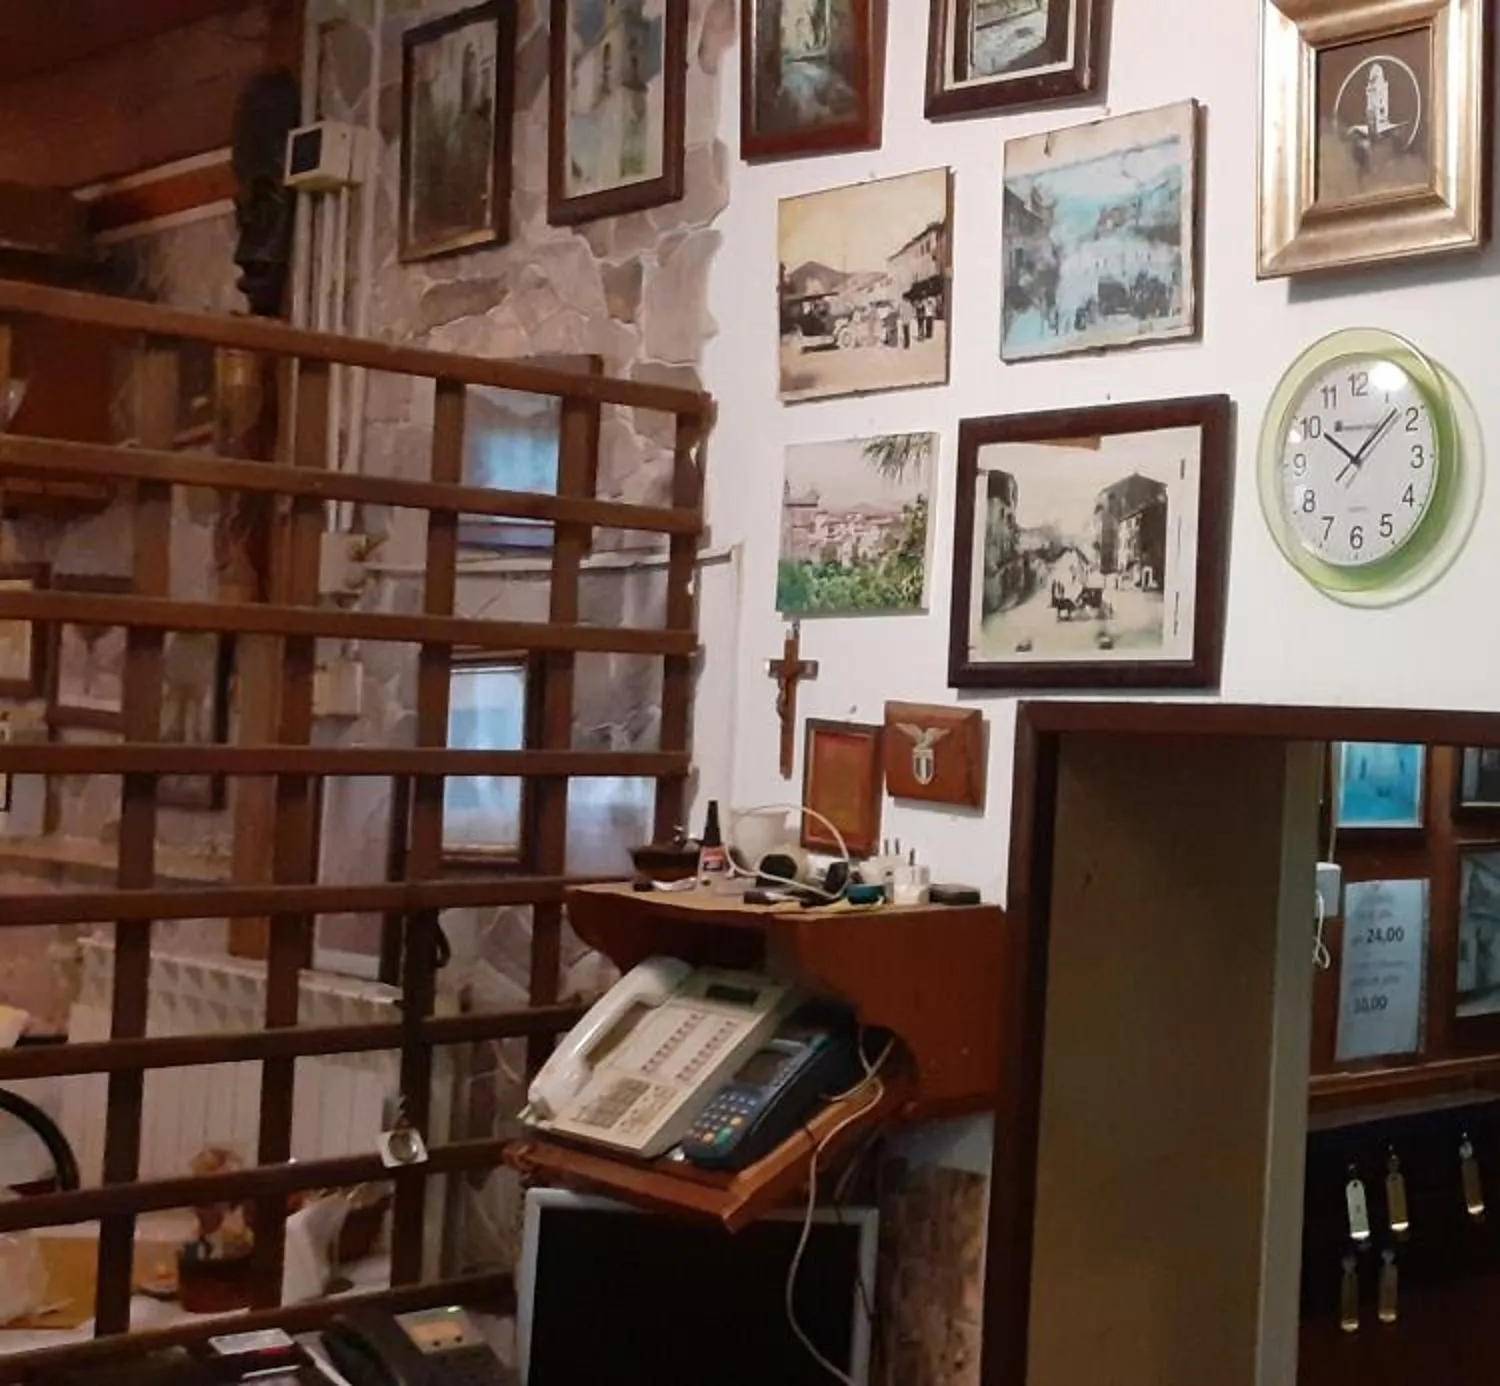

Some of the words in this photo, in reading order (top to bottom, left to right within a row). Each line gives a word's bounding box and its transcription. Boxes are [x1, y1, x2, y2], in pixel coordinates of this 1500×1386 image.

[1348, 372, 1369, 397] 12
[1321, 385, 1337, 409] 11
[1300, 415, 1321, 439] 10
[1405, 407, 1419, 432] 2
[1293, 453, 1307, 477] 9
[1410, 445, 1424, 469] 3
[1302, 489, 1316, 513] 8
[1401, 484, 1416, 508] 4
[1321, 517, 1334, 541] 7
[1350, 526, 1363, 550] 6
[1379, 514, 1393, 538] 5
